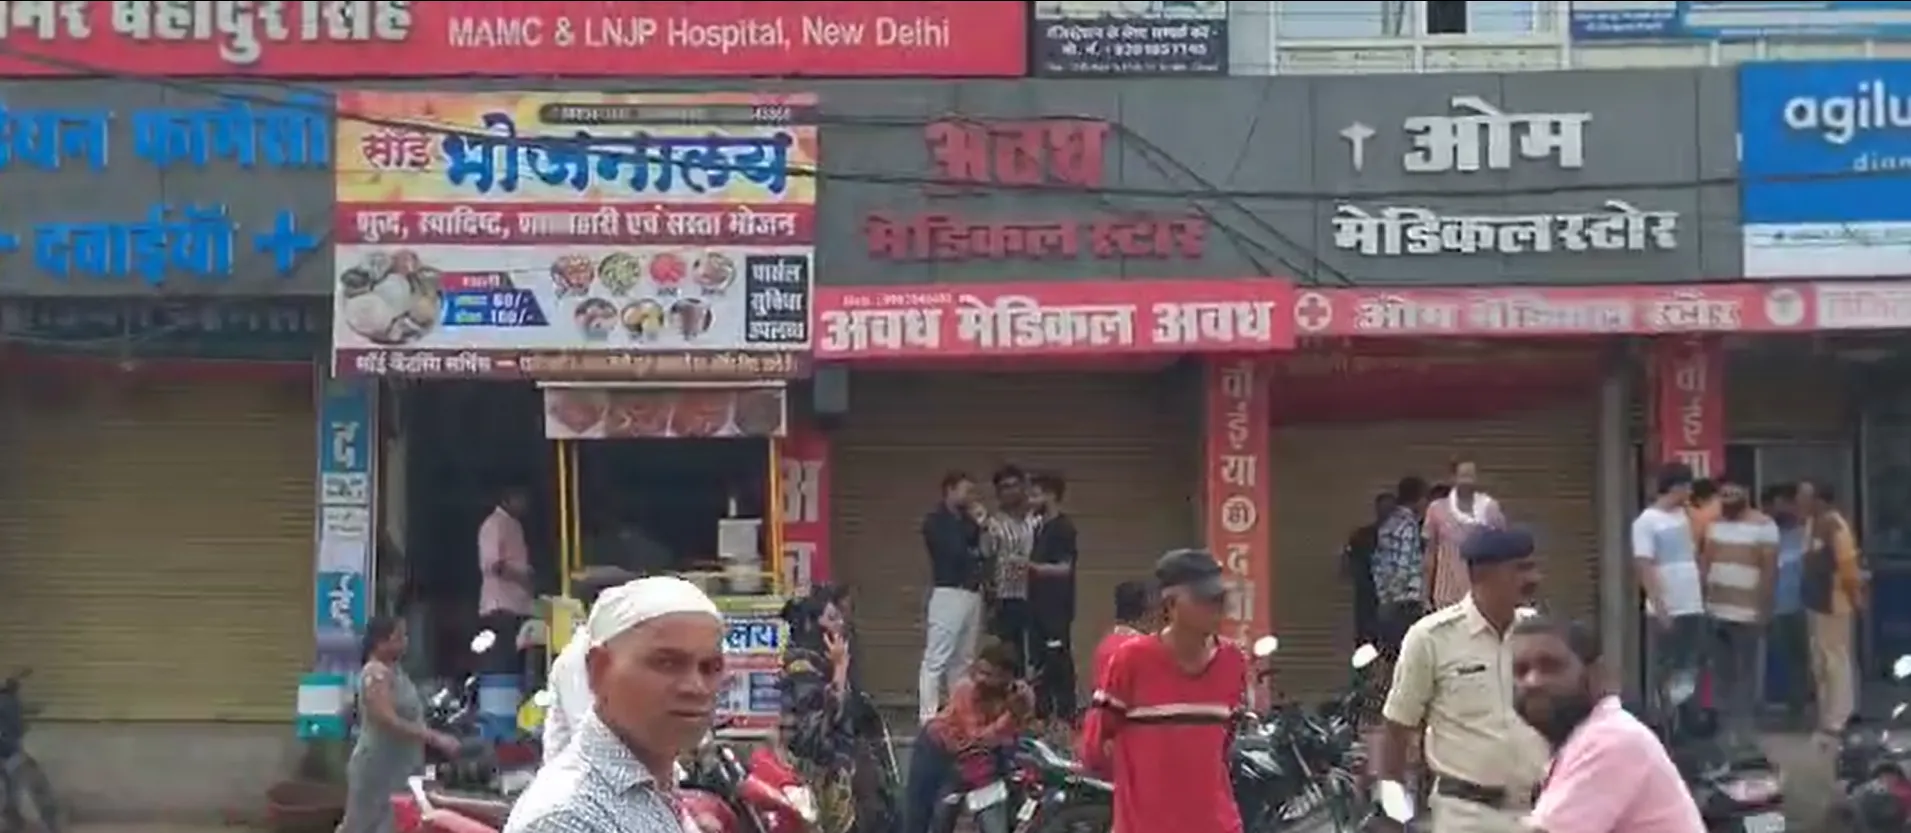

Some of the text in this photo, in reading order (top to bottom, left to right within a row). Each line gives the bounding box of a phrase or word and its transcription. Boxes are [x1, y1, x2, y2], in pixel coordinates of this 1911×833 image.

[449, 14, 950, 53] MAMC & LNJP Hospital, New Delhi
[1403, 96, 1592, 172] ओम
[730, 206, 796, 236] भोजन
[1331, 200, 1679, 255] मेडिकल स्टोर
[820, 295, 1275, 351] अवध मेडिकल अवध
